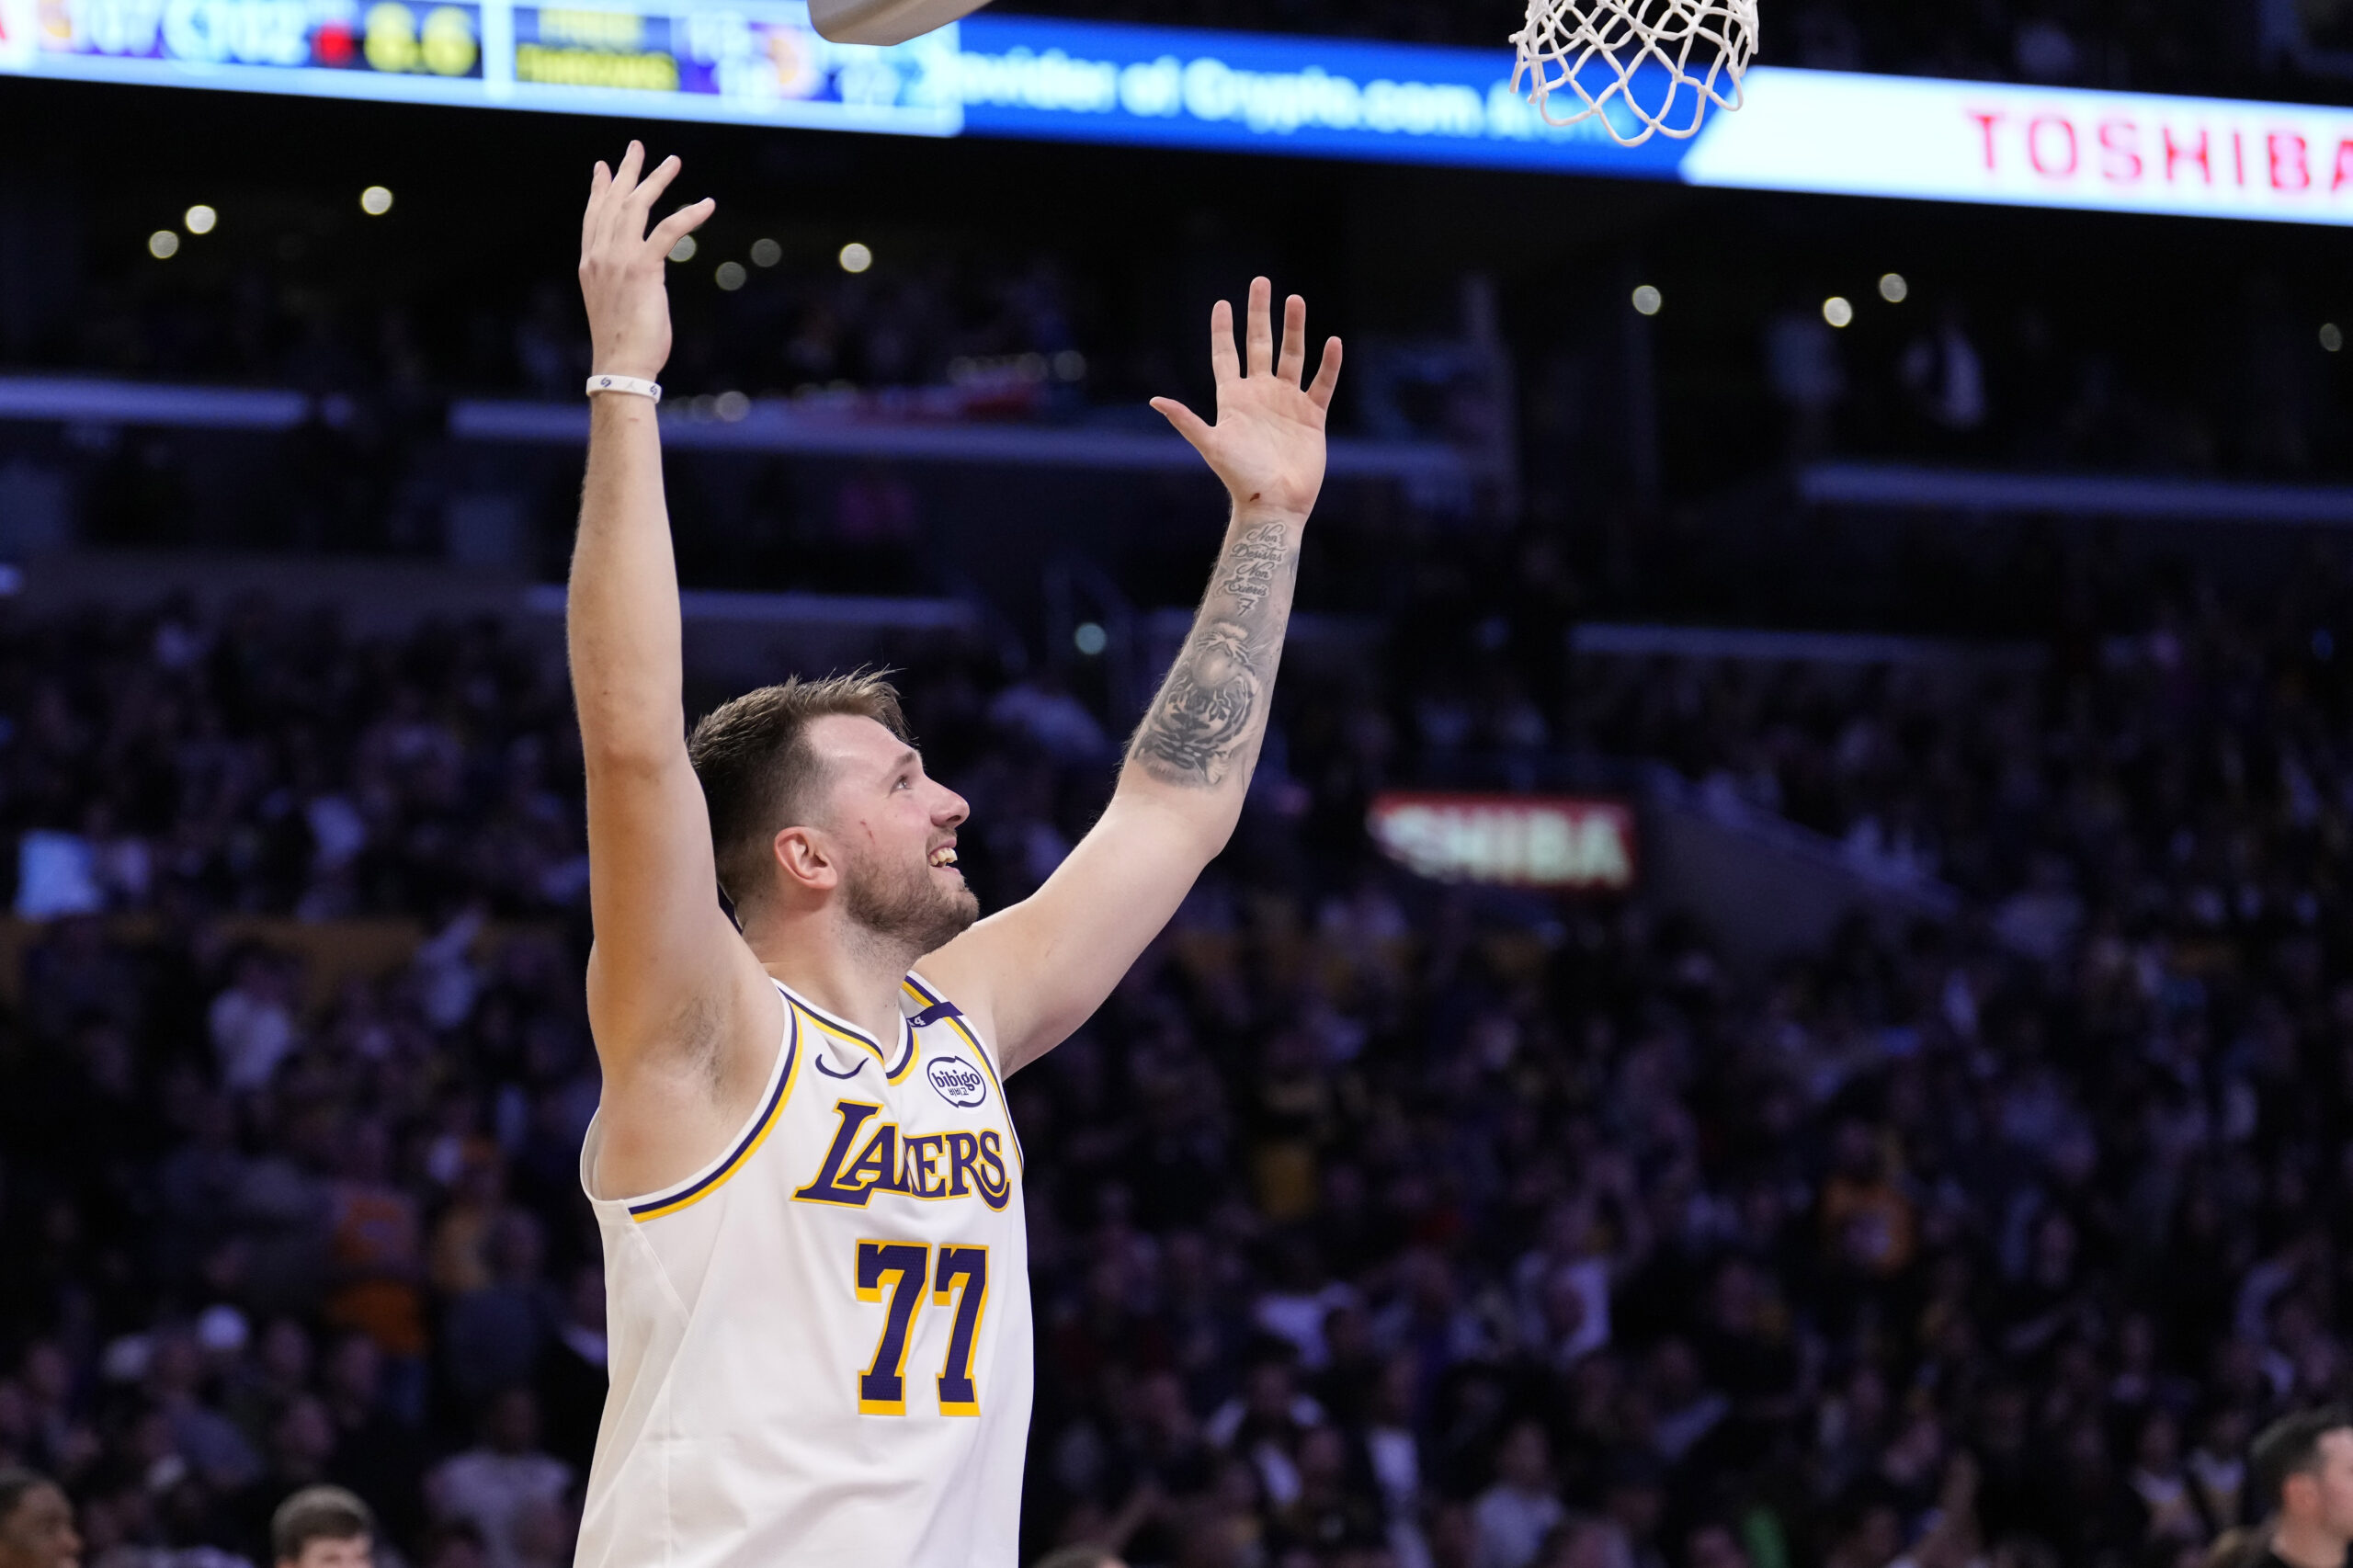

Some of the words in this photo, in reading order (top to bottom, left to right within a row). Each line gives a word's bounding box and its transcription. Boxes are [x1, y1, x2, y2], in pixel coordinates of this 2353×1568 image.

[1121, 55, 1183, 118] of
[1184, 57, 1484, 136] Crypto.com
[1379, 804, 1631, 885] SHIBA
[931, 1069, 981, 1092] bibigo
[854, 1238, 990, 1417] 77
